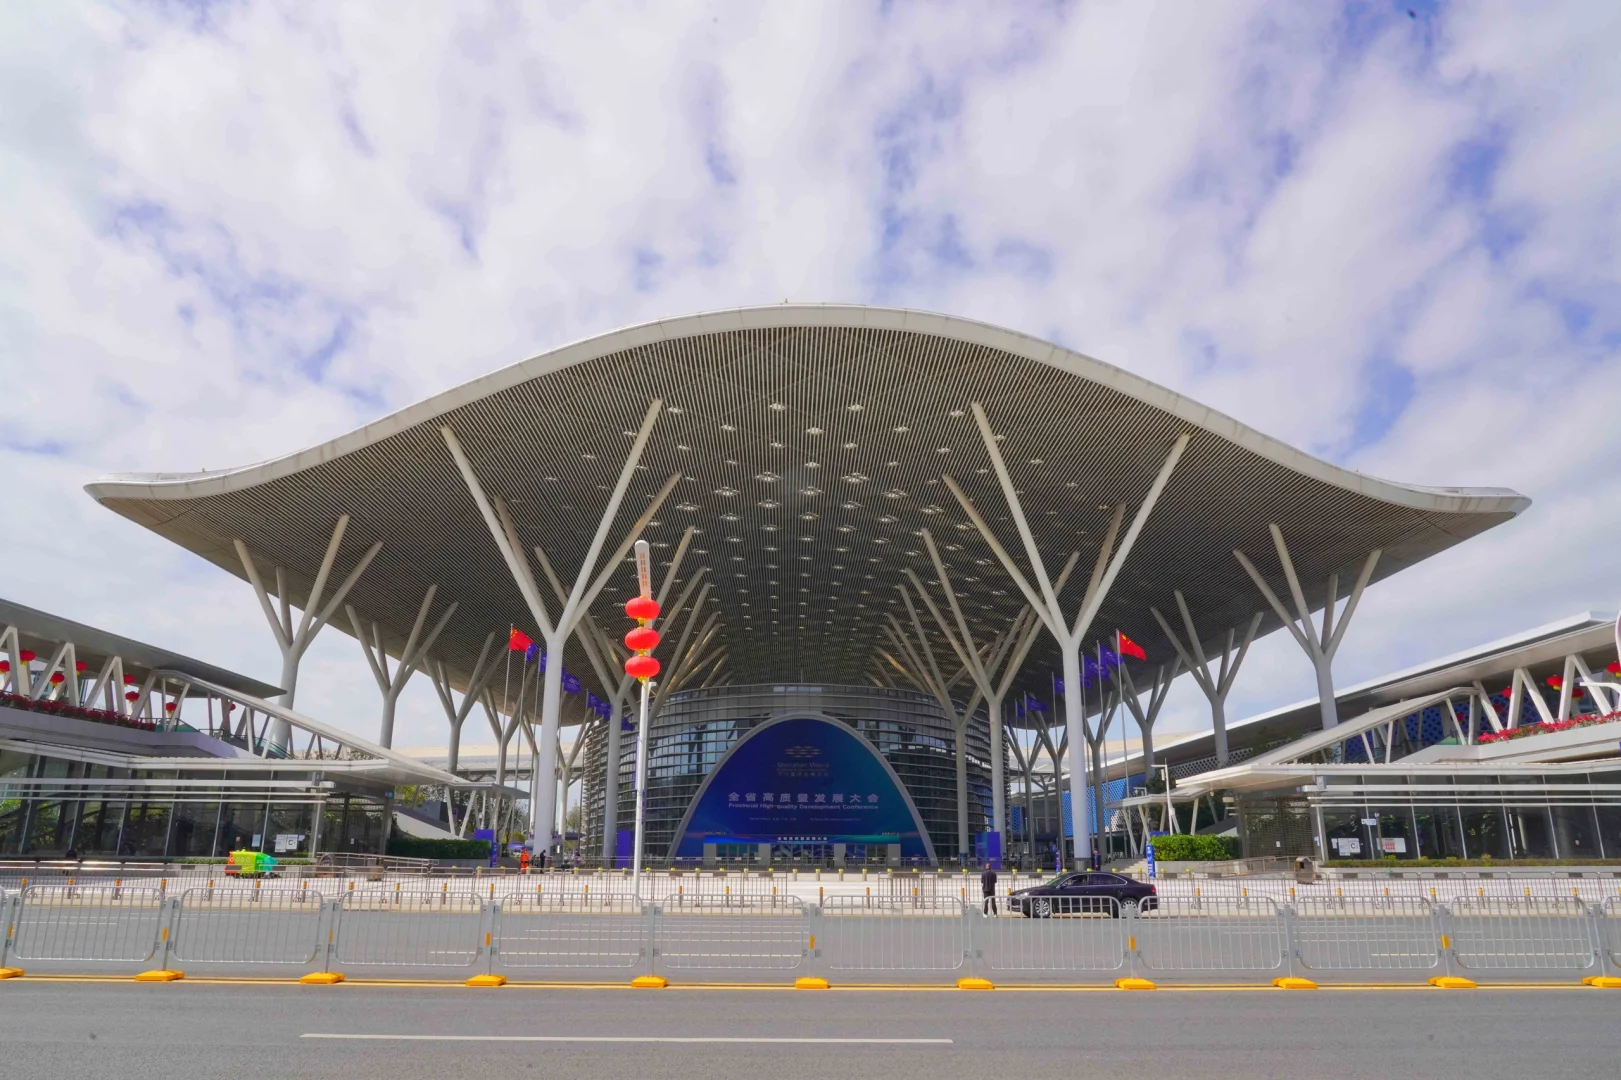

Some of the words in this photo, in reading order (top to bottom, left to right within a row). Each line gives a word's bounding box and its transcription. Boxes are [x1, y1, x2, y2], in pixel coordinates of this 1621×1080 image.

[728, 792, 879, 803] 全省高质量发展大会
[760, 803, 797, 811] High-quality
